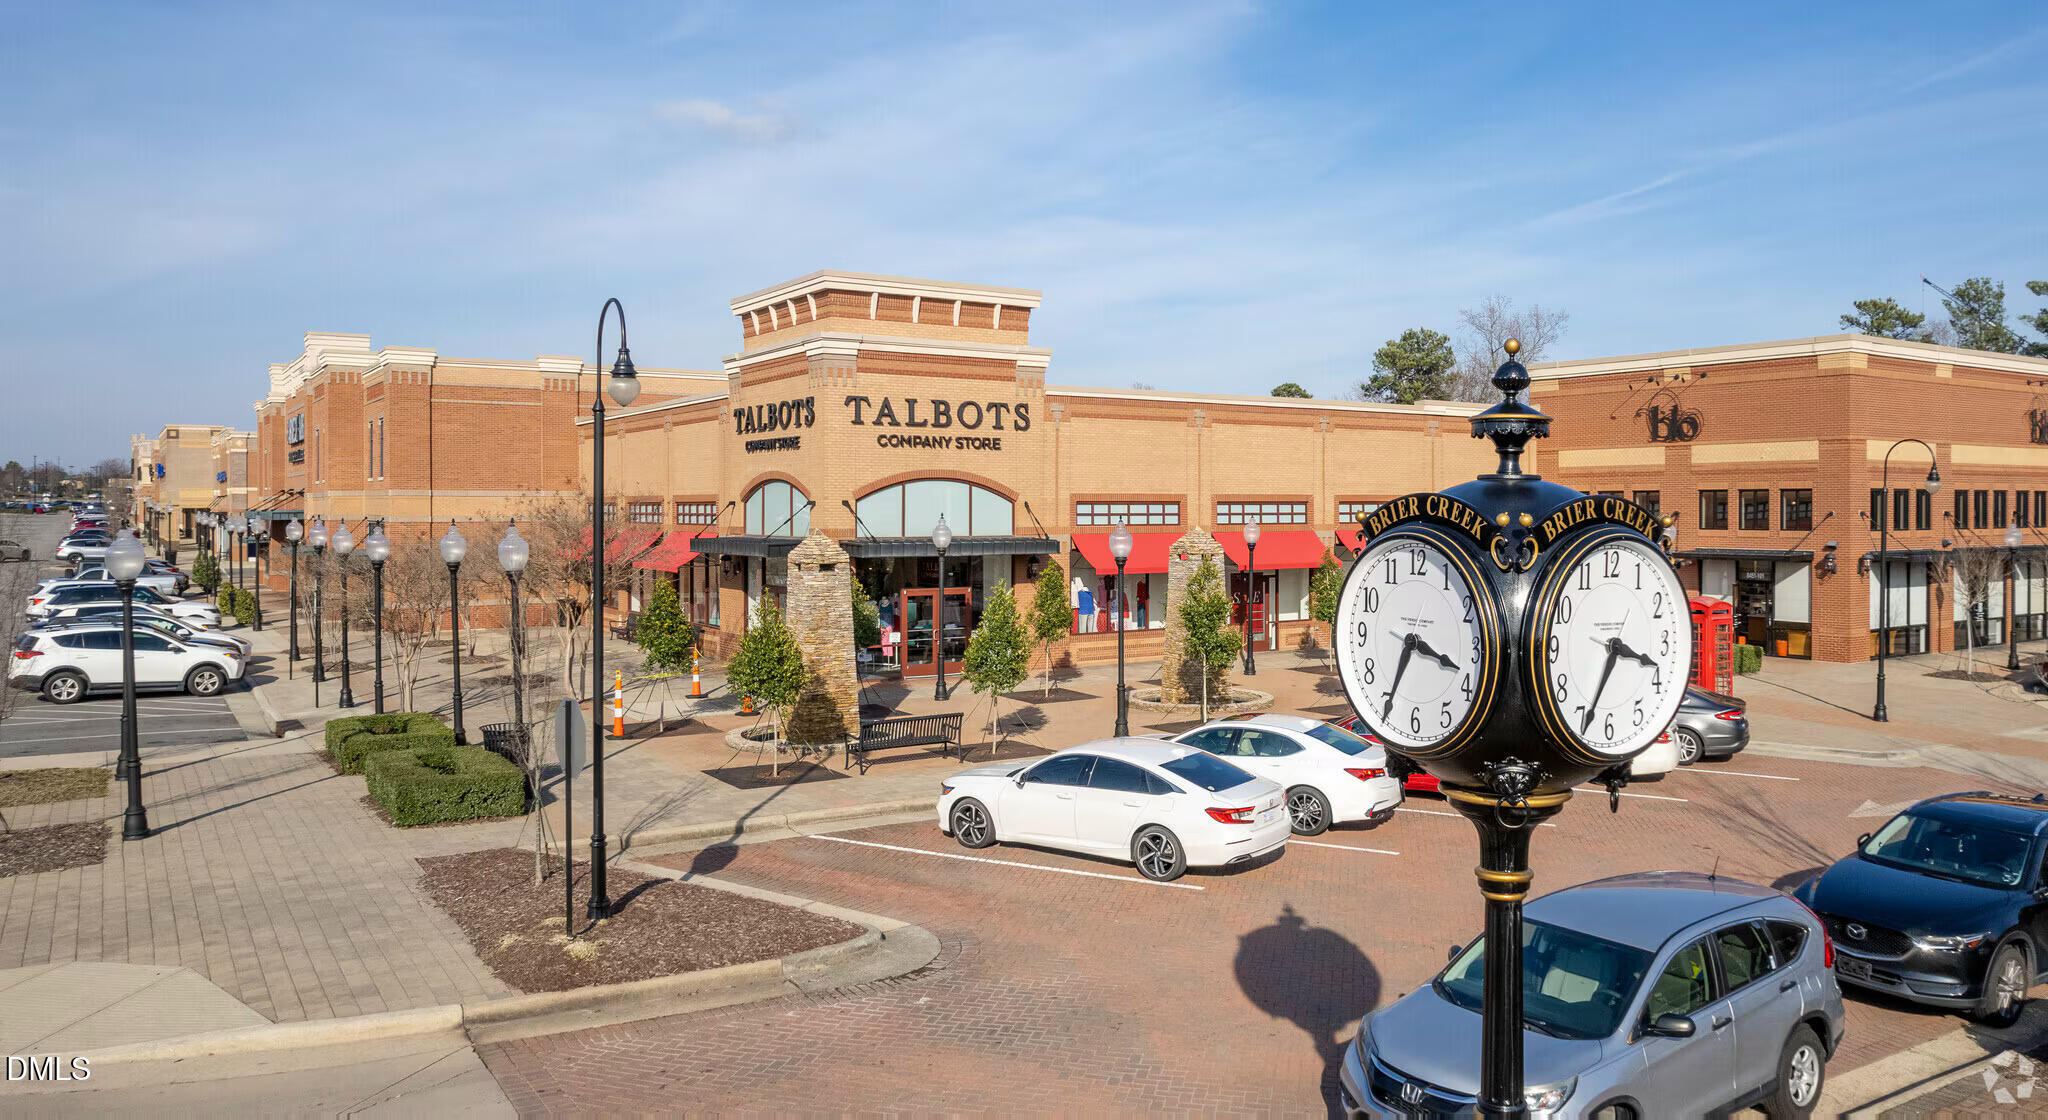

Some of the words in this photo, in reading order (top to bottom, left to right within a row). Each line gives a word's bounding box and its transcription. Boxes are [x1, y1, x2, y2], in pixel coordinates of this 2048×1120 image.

[733, 396, 816, 435] TALBOTS
[844, 395, 1031, 432] TALBOTS
[877, 434, 953, 449] COMPANY
[955, 436, 1002, 451] STORE
[1369, 496, 1420, 536] BRIER
[1426, 495, 1489, 541] CREEK
[1542, 498, 1598, 542] BRIER
[1603, 497, 1658, 541] CREEK
[1384, 558, 1398, 585] 11
[1409, 549, 1428, 576] 12
[1442, 563, 1450, 590] 1
[1578, 562, 1592, 590] 11
[1602, 551, 1620, 579] 12
[1634, 562, 1642, 590] 1
[1363, 587, 1379, 613] 10
[1462, 595, 1474, 623] 2
[1555, 595, 1572, 625] 10
[1653, 592, 1663, 619] 2
[1358, 621, 1367, 647] 9
[1660, 630, 1669, 656] 3
[1471, 636, 1480, 664] 3
[1550, 635, 1559, 664] 9
[1364, 658, 1375, 685] 8
[1652, 665, 1662, 694] 4
[1461, 673, 1473, 702] 4
[1557, 673, 1568, 703] 8
[1410, 706, 1420, 734] 6
[1440, 700, 1452, 728] 5
[1574, 705, 1586, 735] 7
[1633, 698, 1644, 726] 5
[1604, 713, 1614, 741] 6
